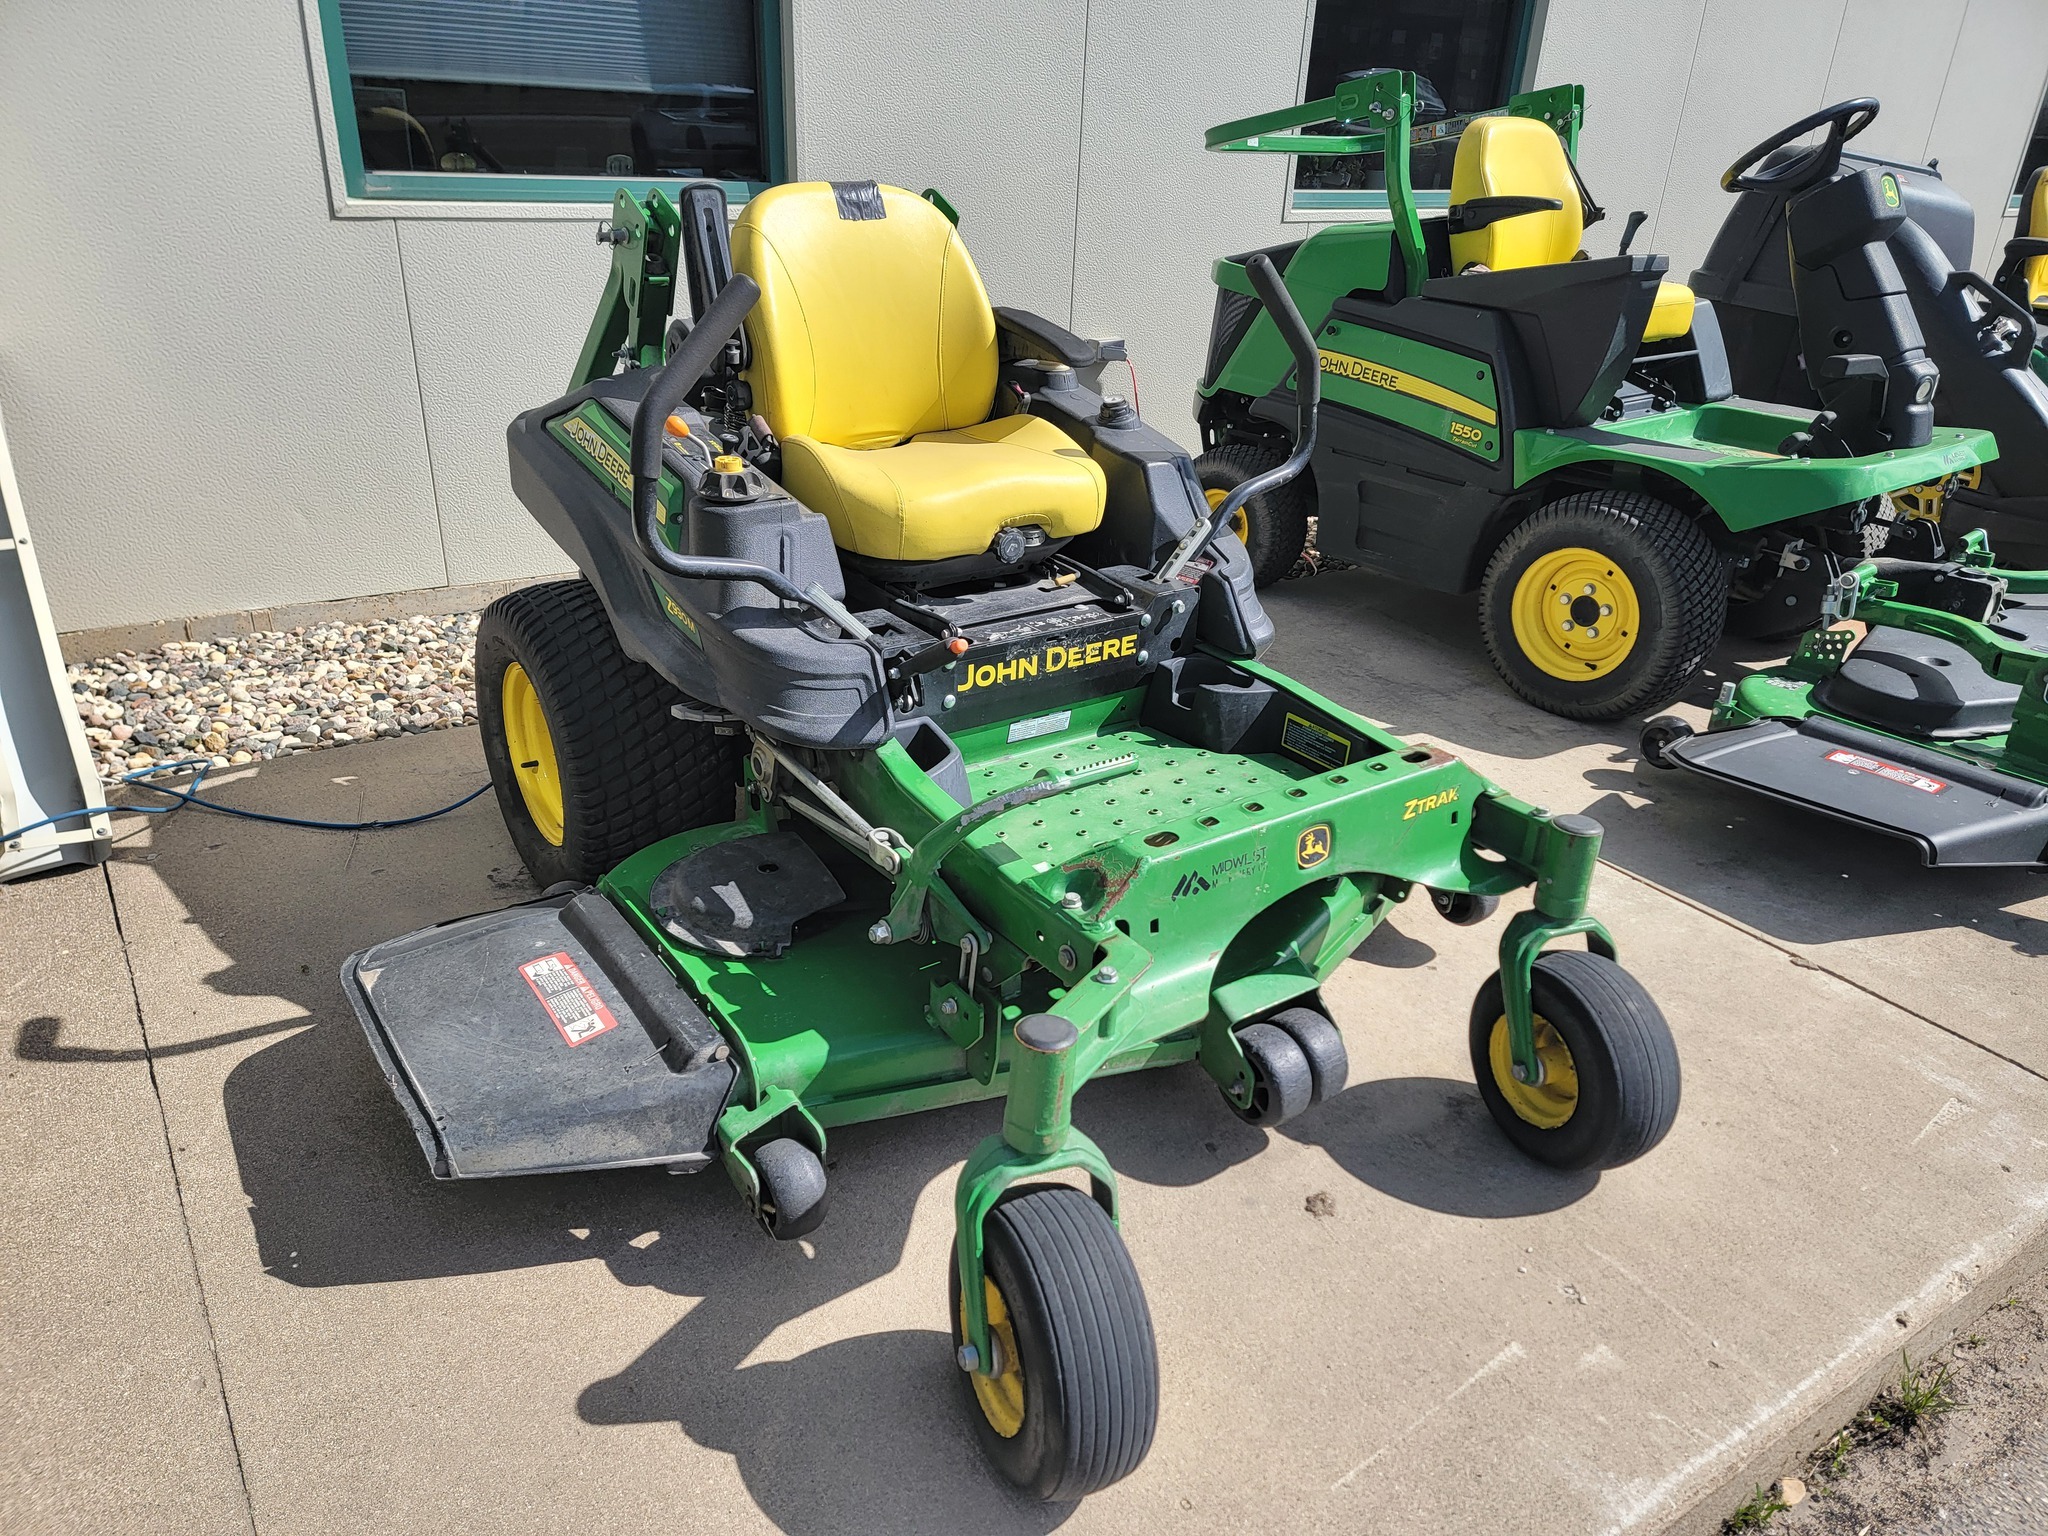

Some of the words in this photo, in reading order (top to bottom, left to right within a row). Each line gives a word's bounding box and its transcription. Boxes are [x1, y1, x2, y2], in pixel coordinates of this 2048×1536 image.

[1319, 354, 1349, 374] OHN
[1351, 361, 1399, 388] DEERE
[1450, 421, 1482, 442] 1550
[571, 421, 598, 457] JOHN
[597, 442, 632, 486] DEERE
[957, 654, 1038, 692] JOHN
[1046, 634, 1138, 673] DEERE
[1402, 787, 1460, 821] ZTRAK
